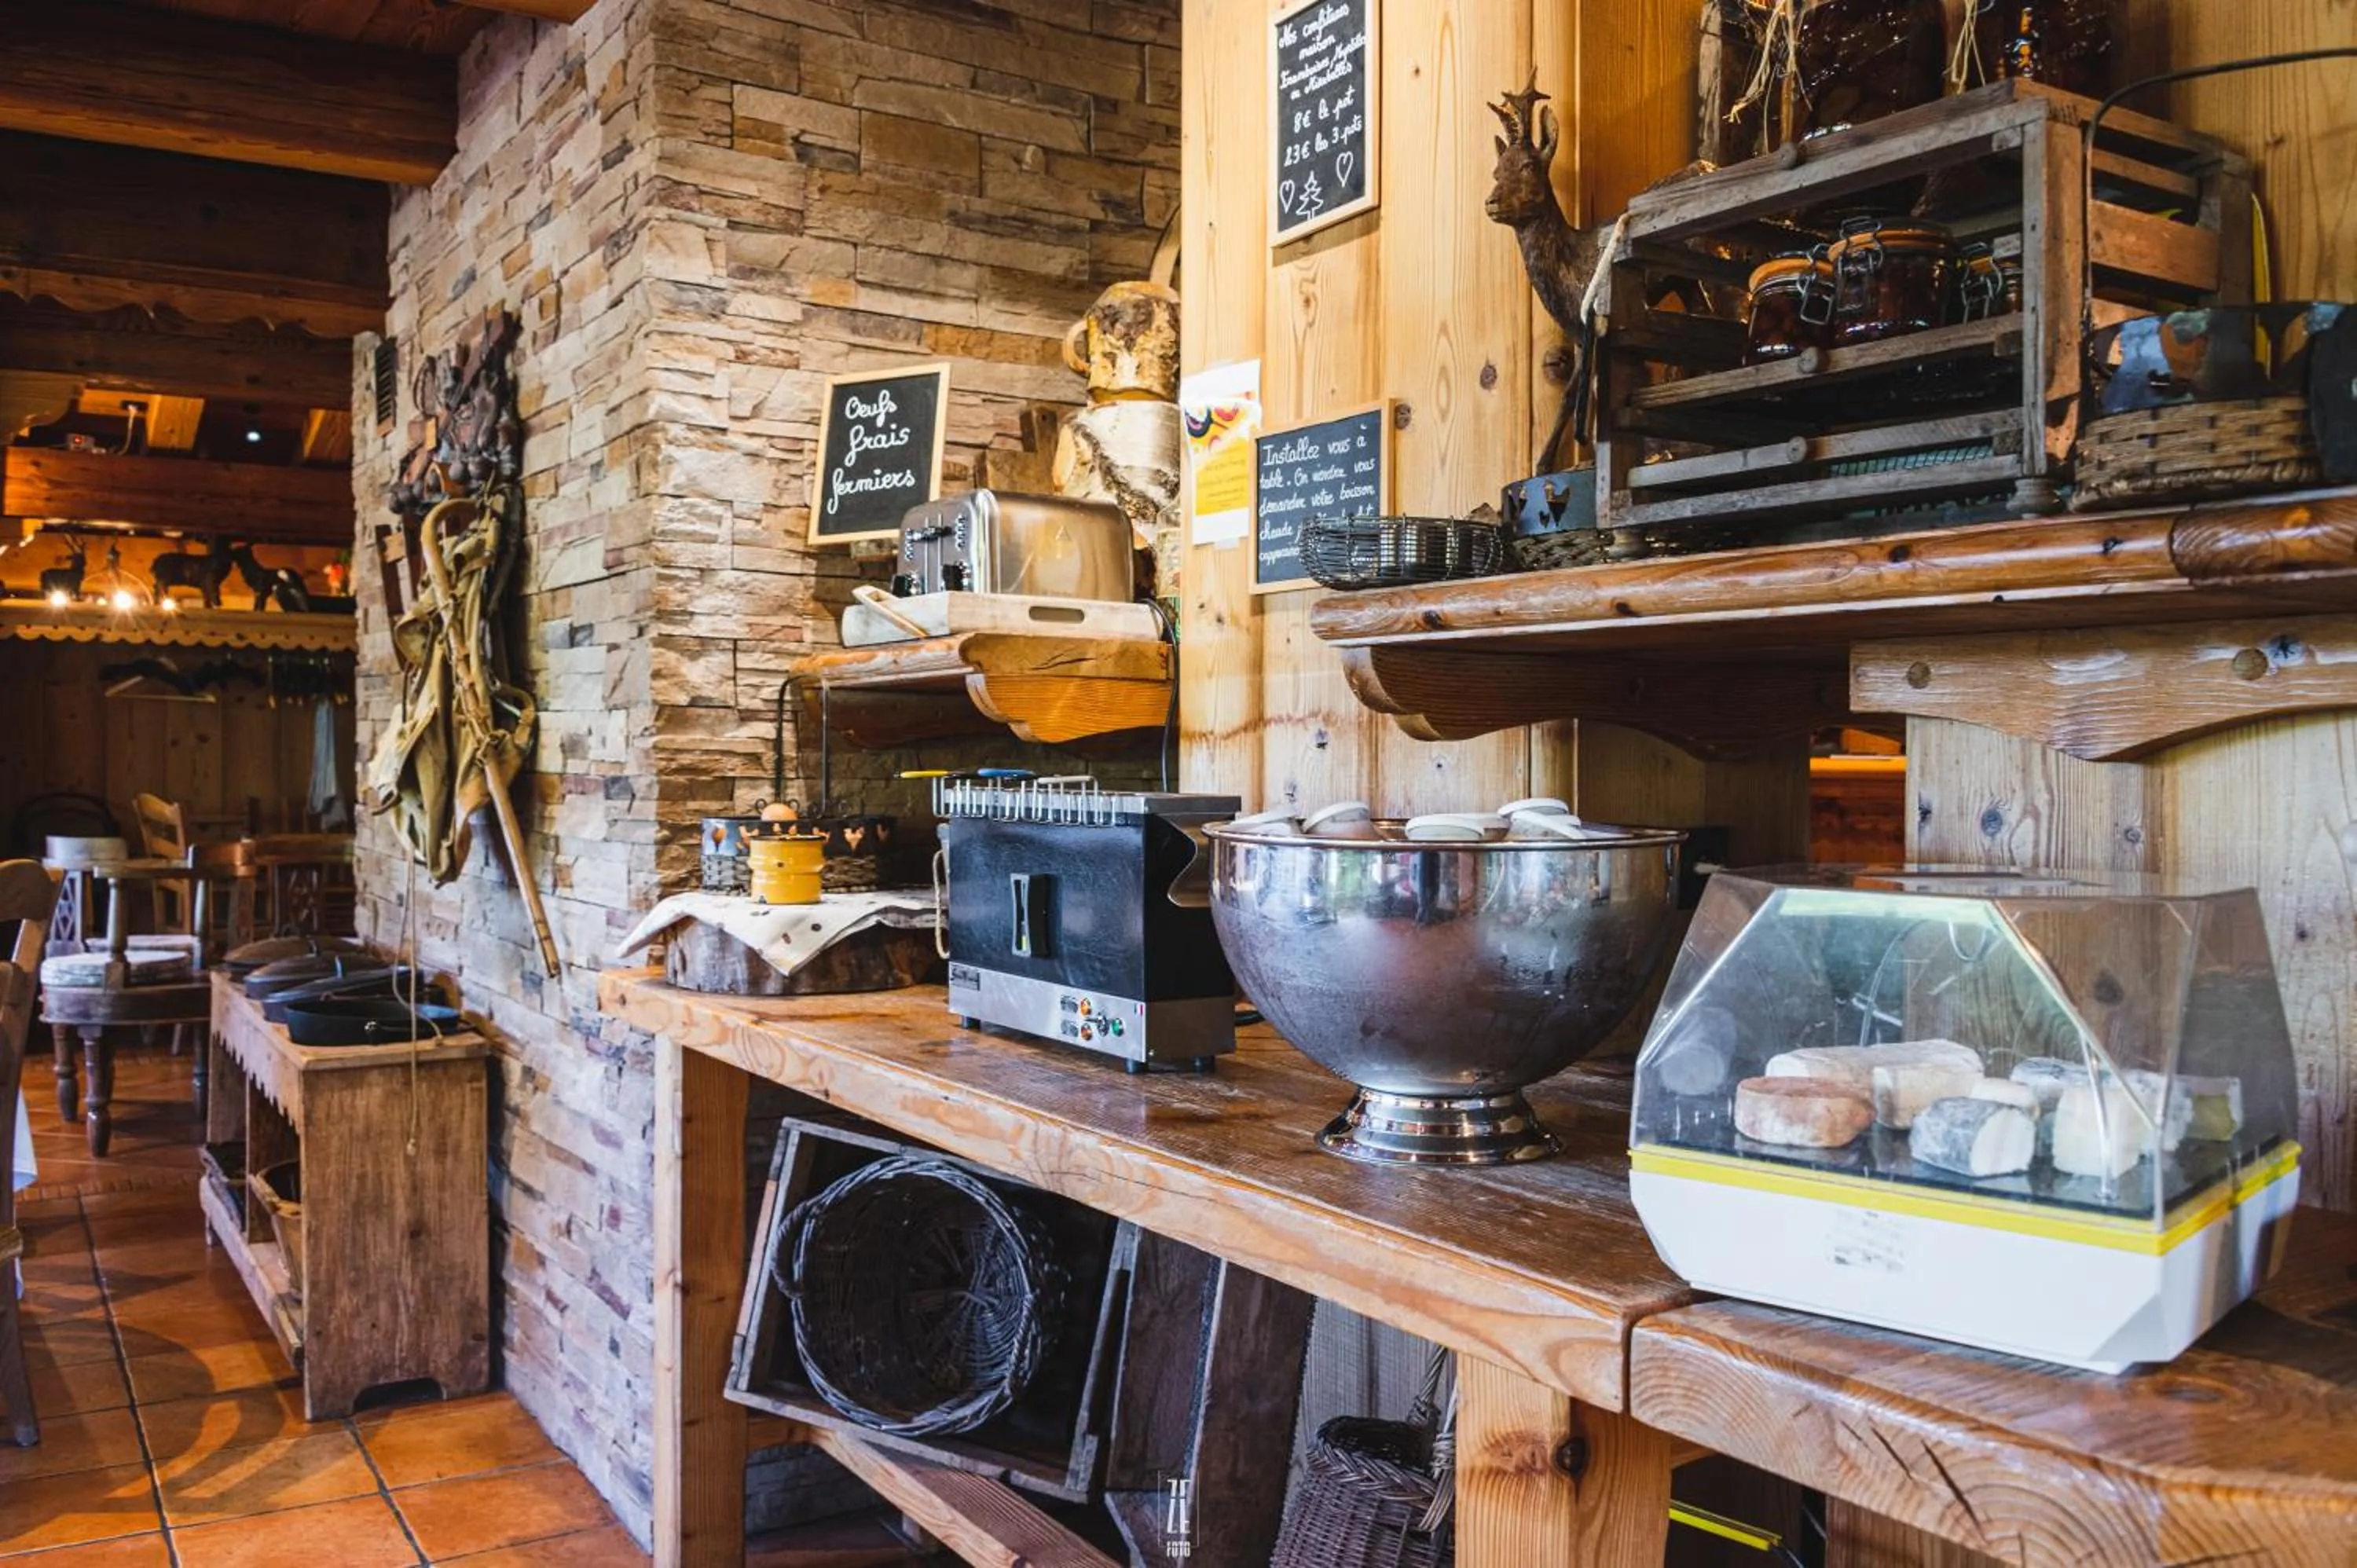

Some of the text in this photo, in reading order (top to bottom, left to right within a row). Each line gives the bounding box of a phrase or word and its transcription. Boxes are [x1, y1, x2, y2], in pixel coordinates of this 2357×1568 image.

[1299, 35, 1336, 60] maison
[1294, 83, 1355, 134] 8€ le pot
[1284, 114, 1362, 167] 23€ les 3 pots
[845, 390, 898, 427] Oeufs
[845, 424, 911, 467] frais
[1263, 435, 1320, 466] Installez
[1328, 438, 1351, 455] vous
[1294, 467, 1309, 486] On
[1354, 458, 1375, 473] vous
[827, 468, 915, 515] fermiers
[1259, 492, 1307, 518] demander
[1311, 488, 1334, 507] votre
[1340, 481, 1375, 500] boisson
[1259, 519, 1292, 540] chaude
